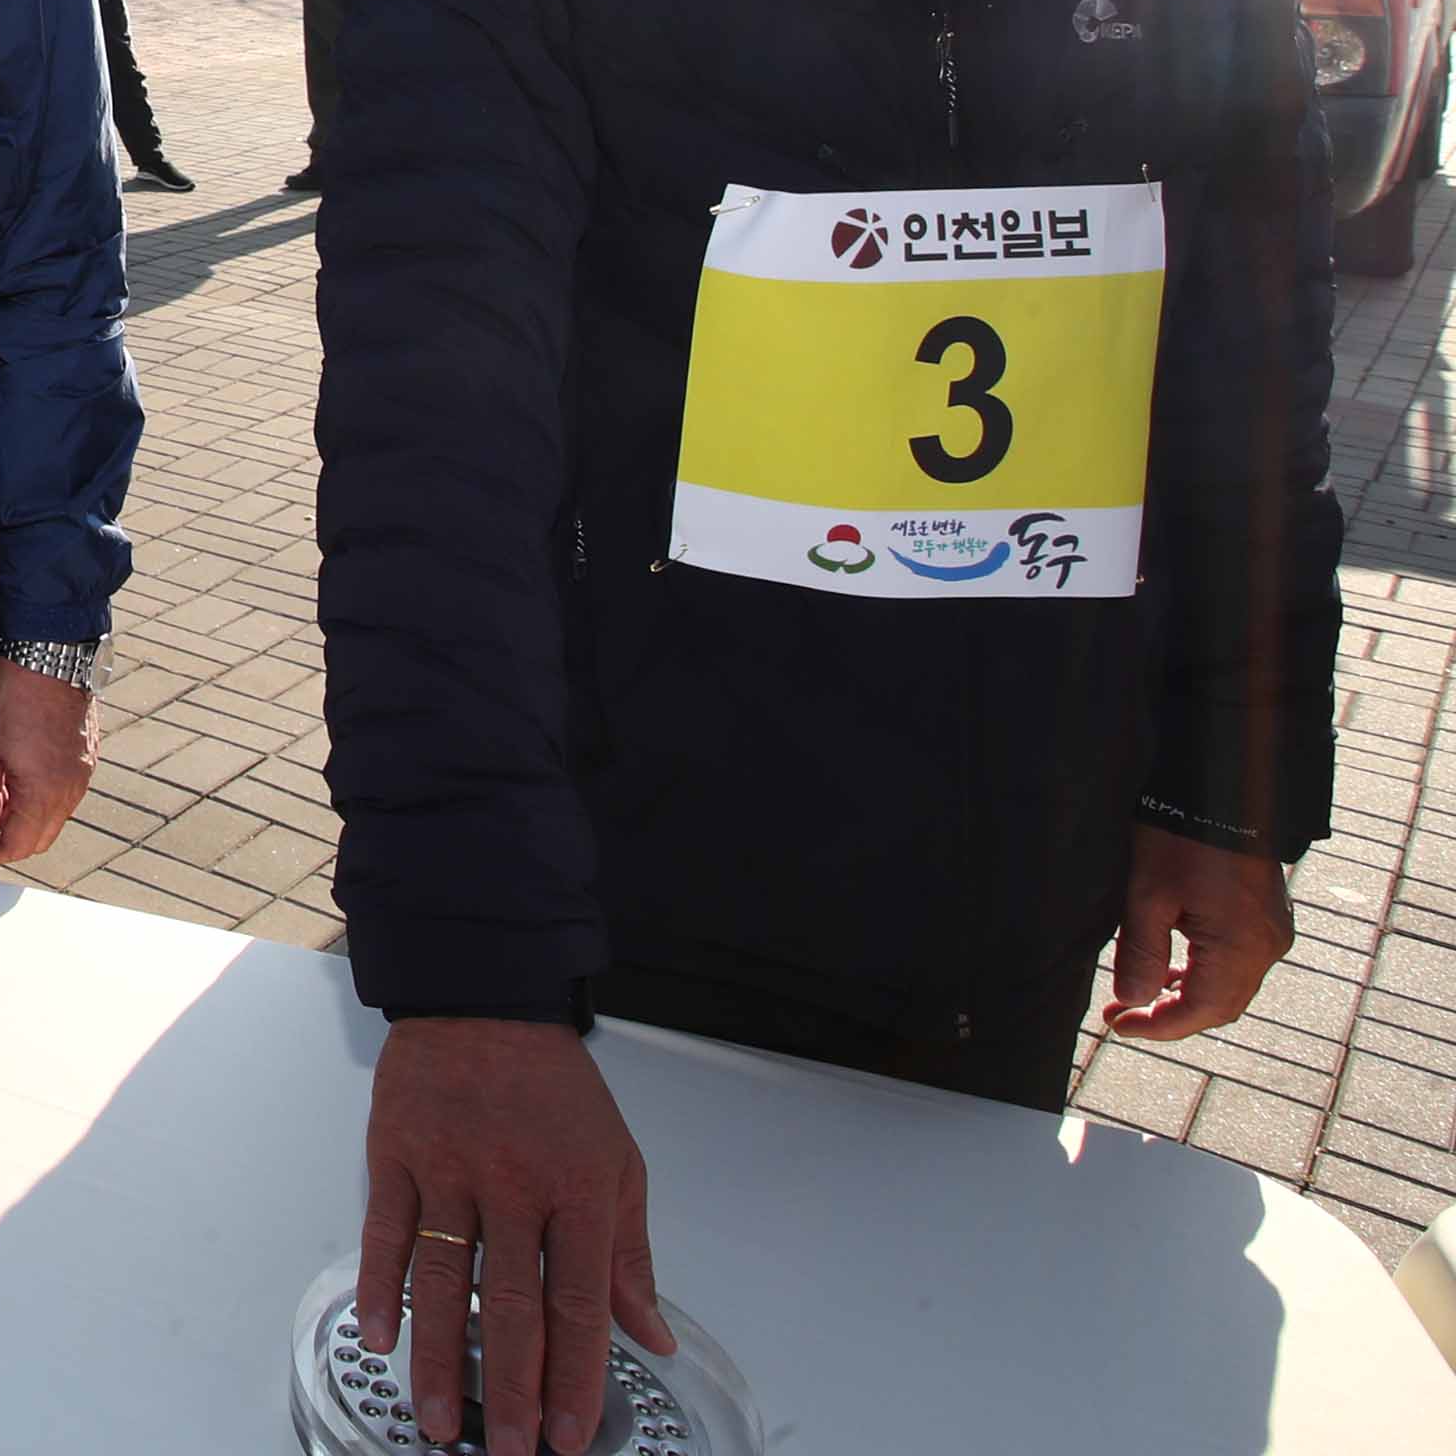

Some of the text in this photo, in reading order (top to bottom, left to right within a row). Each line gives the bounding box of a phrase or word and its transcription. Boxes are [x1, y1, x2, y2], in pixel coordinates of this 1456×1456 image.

[903, 209, 1092, 262] 인천일보
[908, 315, 1013, 484] 3
[891, 519, 966, 537] 새로운 변화
[913, 536, 989, 559] 모두가 행복한
[1008, 512, 1089, 590] 동구
